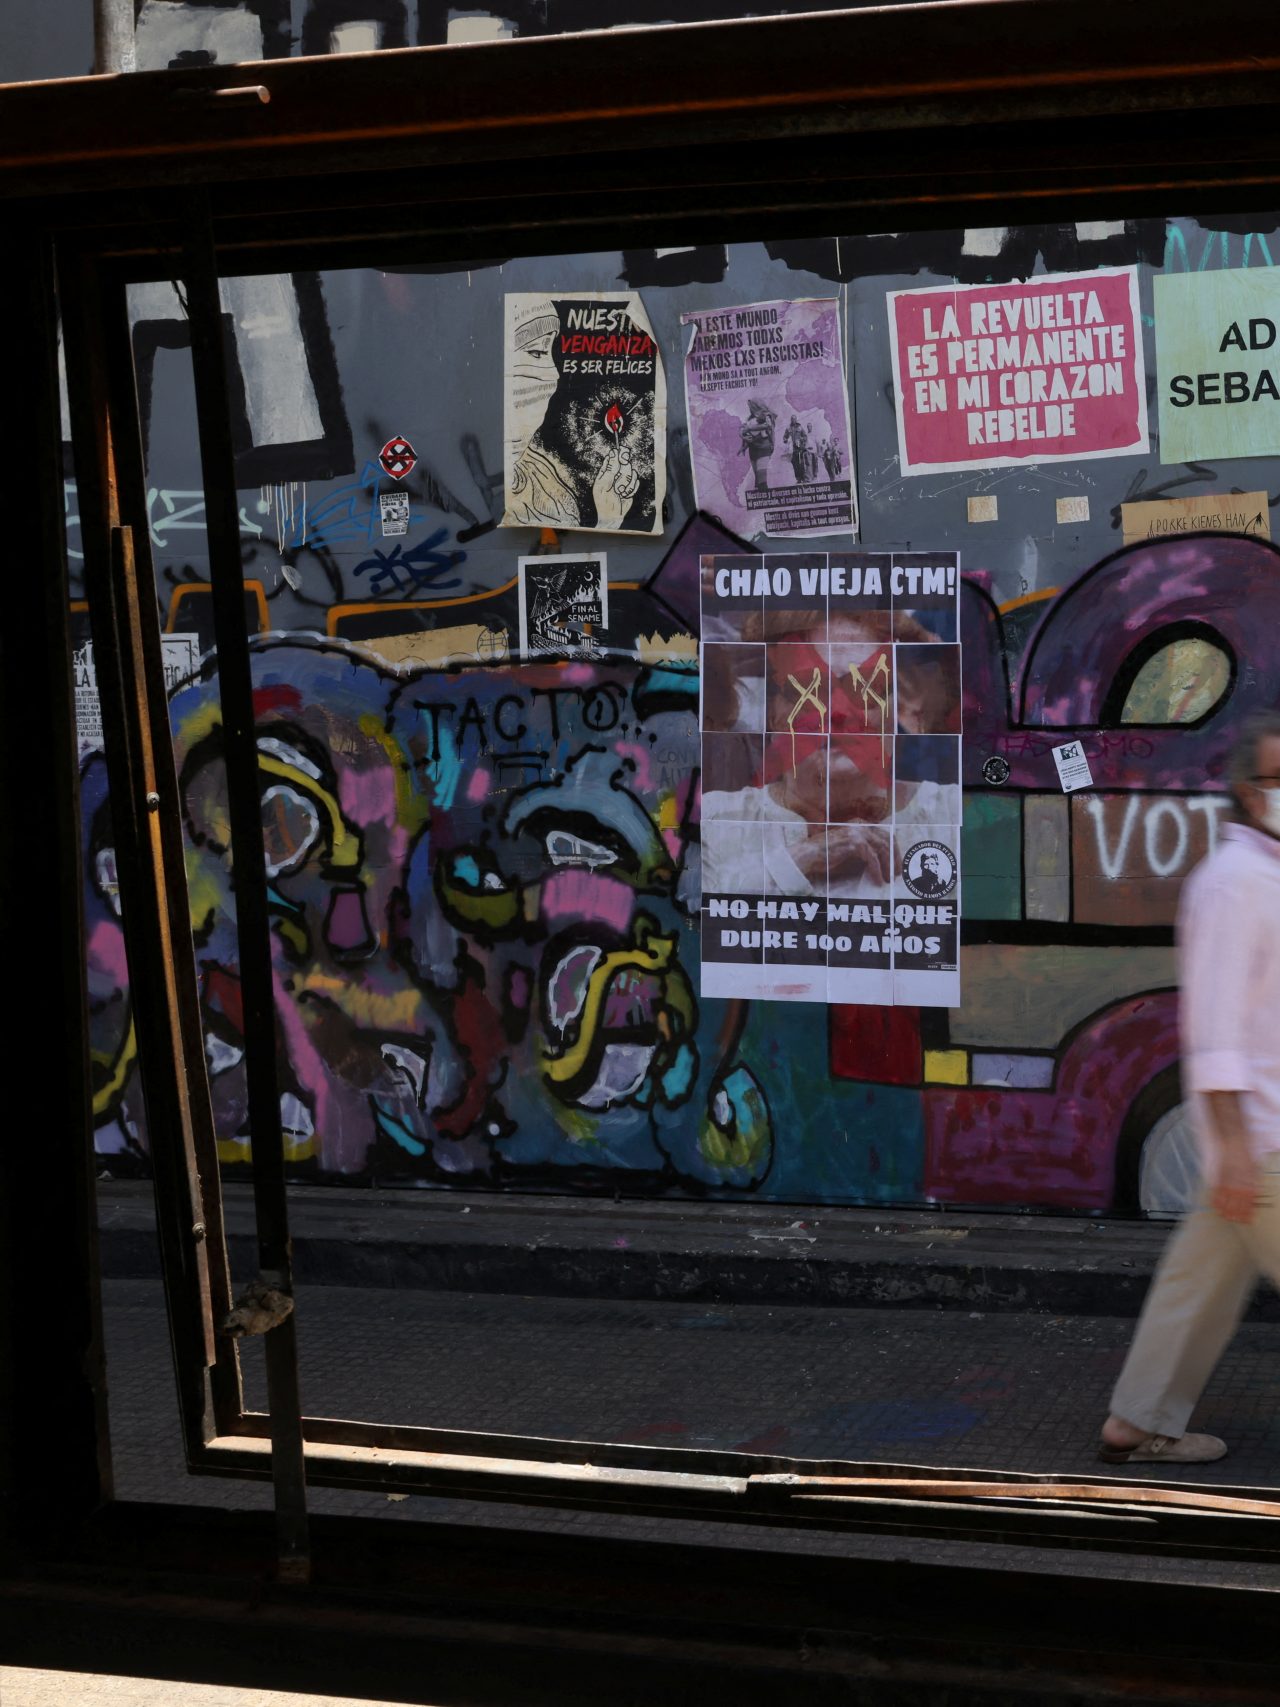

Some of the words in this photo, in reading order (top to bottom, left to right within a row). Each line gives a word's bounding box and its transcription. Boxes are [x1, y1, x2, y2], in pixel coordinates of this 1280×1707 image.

[706, 314, 733, 332] ESTE
[736, 308, 778, 329] MUNDO
[922, 304, 961, 341] LA
[970, 290, 1105, 336] REVUELTA
[560, 335, 655, 356] VENGANZA
[746, 326, 784, 347] TODXS
[907, 343, 938, 378] ES
[947, 324, 1126, 375] PERMANENTE
[563, 359, 578, 374] ES
[580, 360, 604, 376] SER
[605, 361, 653, 375] FELICES
[690, 350, 731, 372] MENOS
[734, 348, 756, 367] LXS
[758, 341, 824, 363] FASCISTAS!
[914, 378, 947, 414] EN
[957, 374, 990, 410] MI
[999, 361, 1124, 406] CORAZON
[967, 402, 1076, 445] REBELDE
[715, 568, 792, 598] CHAO
[799, 567, 883, 597] VIEJA
[889, 566, 956, 597] CTM!
[709, 898, 749, 919] NO
[757, 901, 820, 922] HAY
[827, 904, 887, 923] MAL
[894, 904, 953, 929] QUE
[720, 929, 798, 949] DURE
[805, 934, 852, 952] 100
[859, 927, 941, 954] AÑOS
